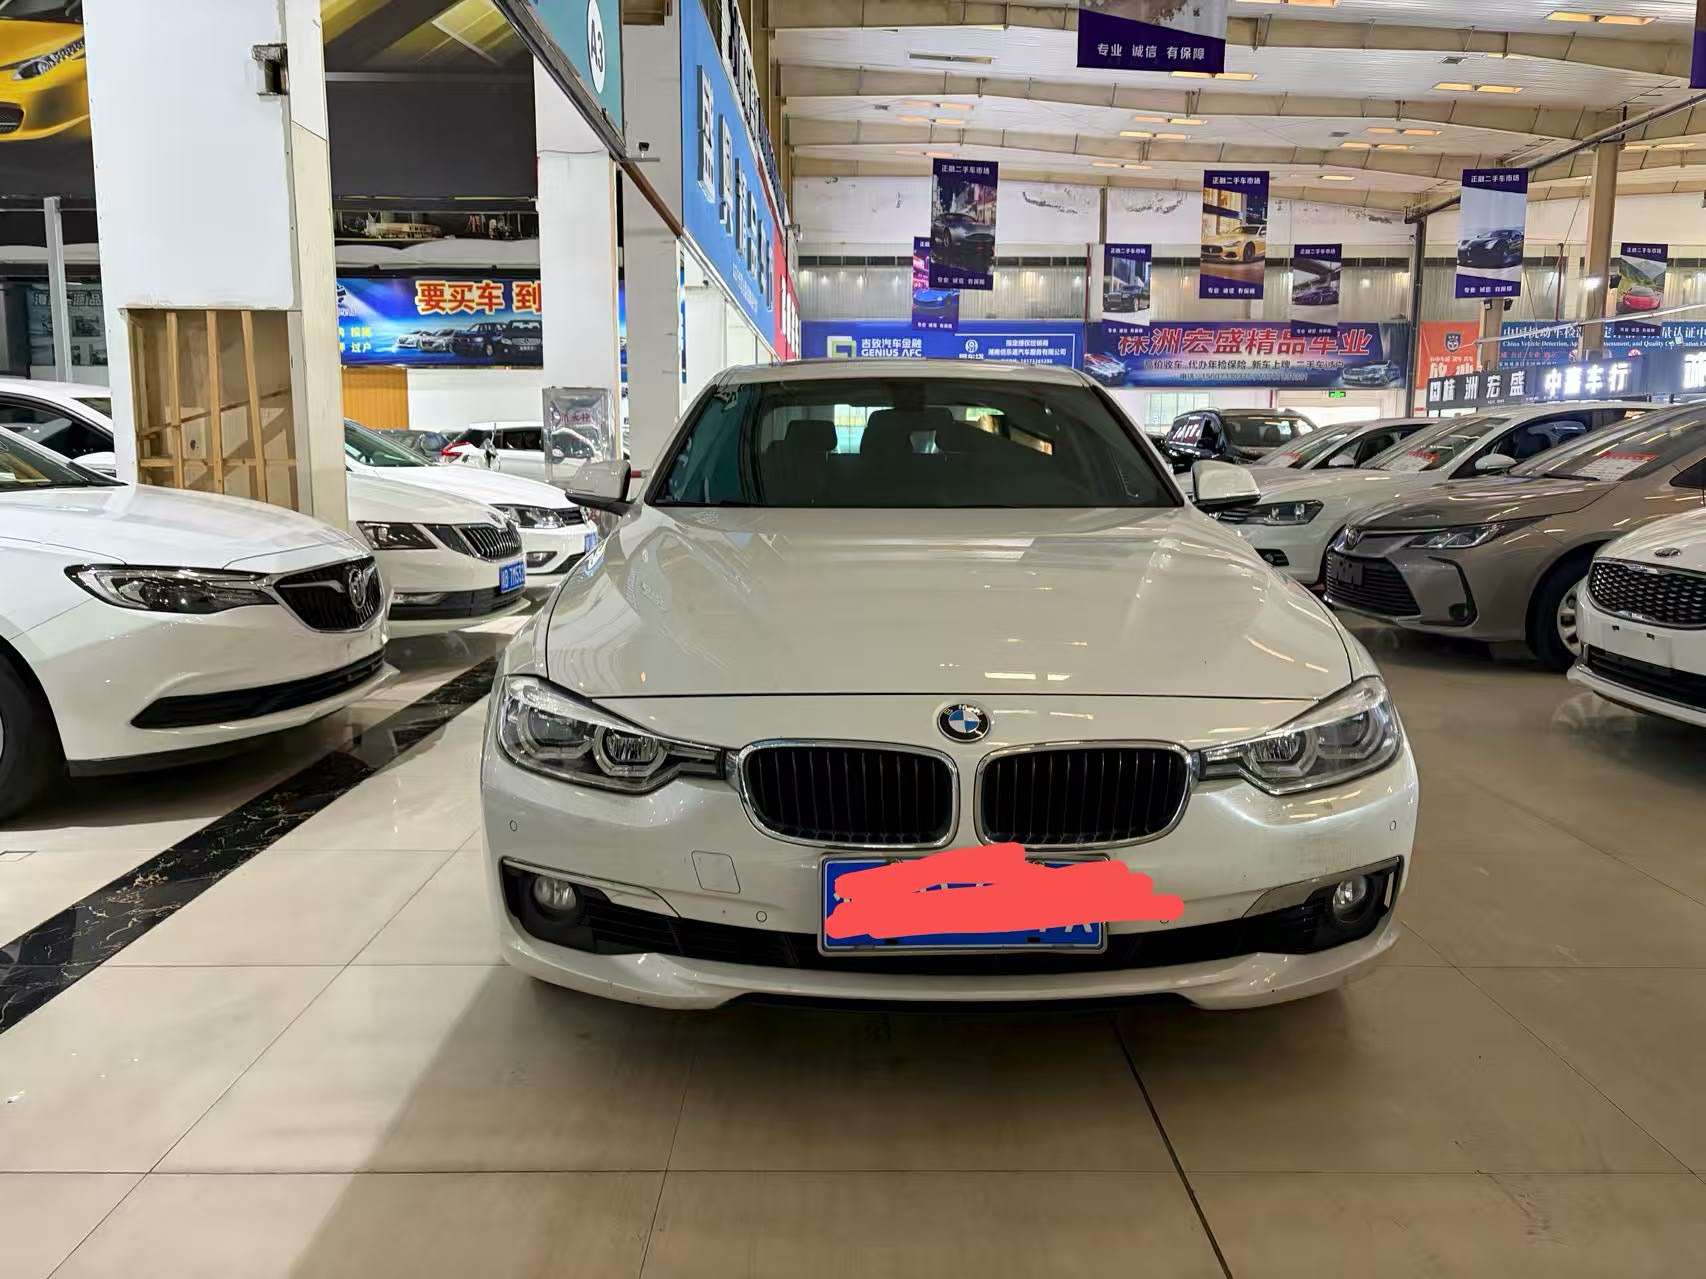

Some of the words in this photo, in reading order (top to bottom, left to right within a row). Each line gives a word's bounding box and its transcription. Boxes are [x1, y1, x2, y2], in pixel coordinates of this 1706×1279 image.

[591, 19, 603, 72] A3
[1097, 43, 1122, 57] 专业
[1132, 44, 1157, 58] 诚信
[1167, 46, 1205, 60] 有保障
[416, 280, 505, 316] 要买车
[861, 338, 922, 349] 吉致汽车金融
[861, 349, 899, 357] GENIUS
[901, 349, 922, 357] AFC
